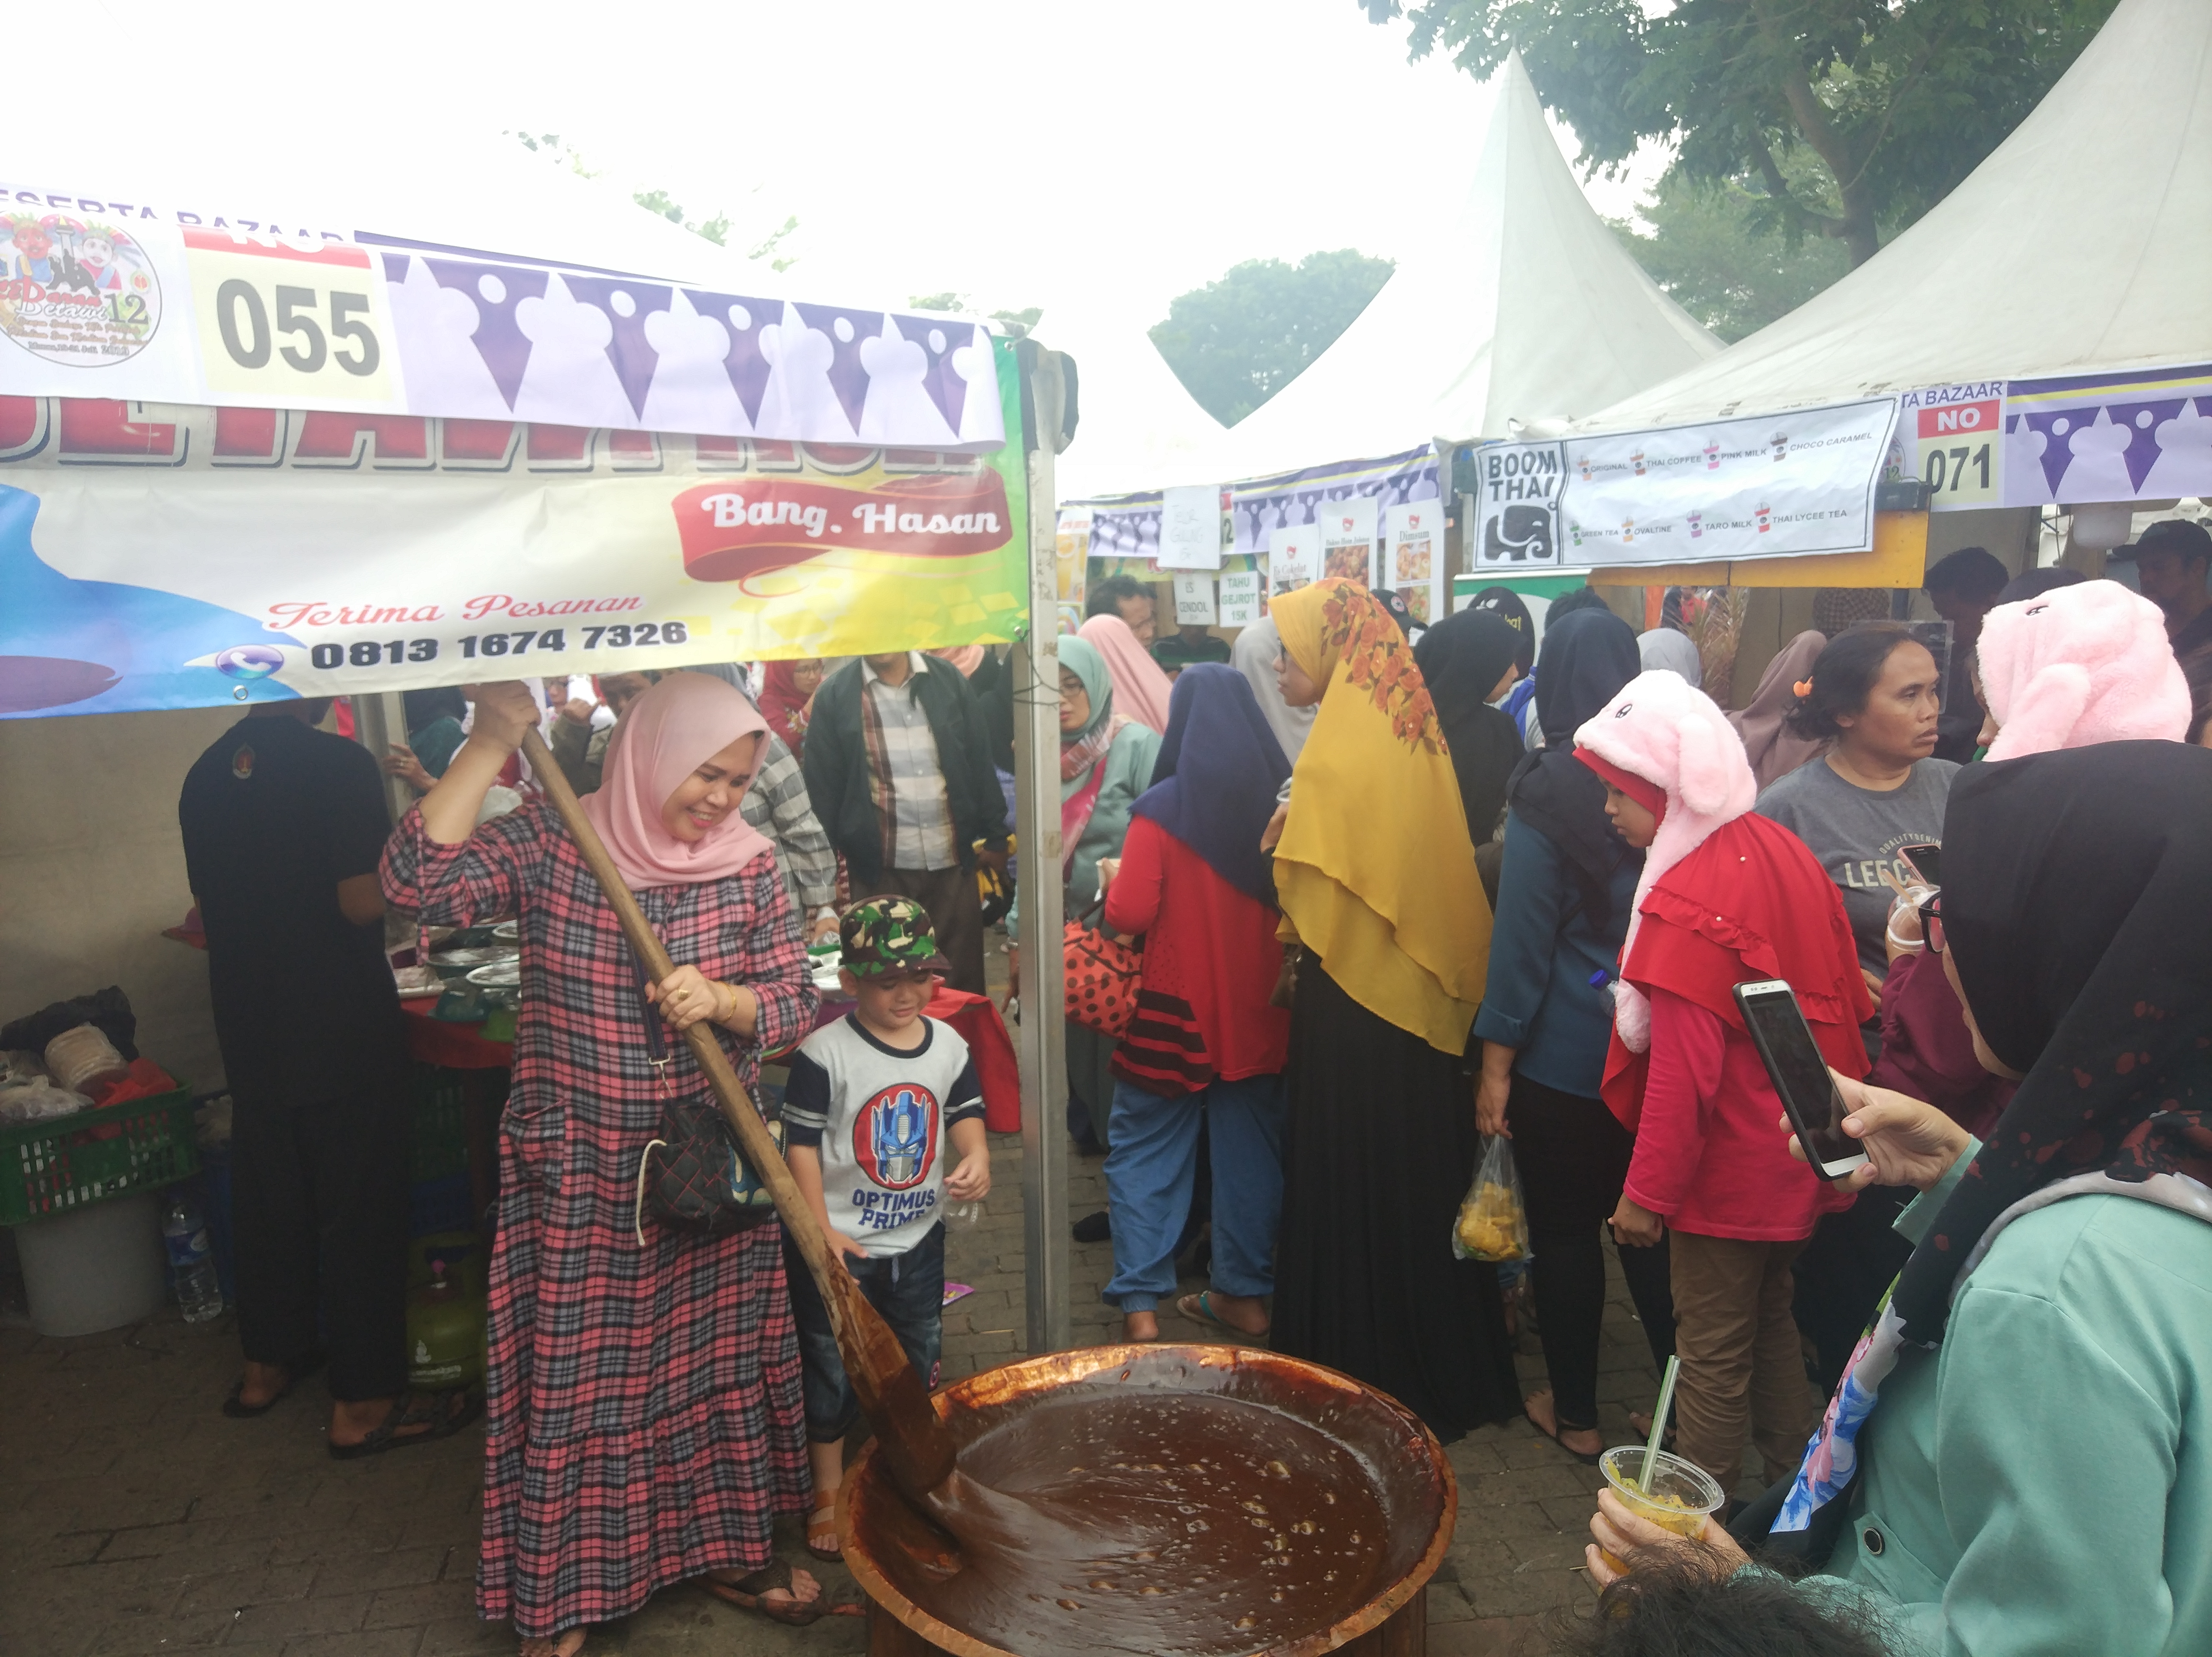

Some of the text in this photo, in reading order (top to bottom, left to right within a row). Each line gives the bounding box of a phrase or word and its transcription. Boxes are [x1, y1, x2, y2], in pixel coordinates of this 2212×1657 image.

[104, 293, 148, 324] 12
[216, 278, 380, 377] 055
[1925, 381, 2002, 405] BAZAAR
[1938, 407, 1980, 431] NO
[1790, 432, 1872, 451] CHOCO CARAMEL
[1667, 456, 1701, 465] COFFEE
[1721, 448, 1767, 460] PINK MILK
[1489, 450, 1557, 478] BOOM
[1591, 464, 1628, 473] ORIGINAL
[1926, 443, 1990, 494] 071
[1489, 476, 1555, 501] THAI
[701, 492, 1001, 538] Bang. Hasan
[1772, 510, 1846, 523] THAI LYCEE TEA
[1634, 525, 1671, 535] OVALTINE
[1705, 520, 1752, 531] TARO MILK
[1399, 530, 1429, 542] Dimsum
[1227, 577, 1249, 588] TAHU
[1179, 602, 1209, 613] CENDOL
[1221, 593, 1256, 604] GEJROT
[268, 594, 643, 630] Terima Pesanan
[1231, 610, 1247, 621] 15K
[310, 622, 687, 669] 0813 1674 7326
[852, 1188, 935, 1209] OPTIMUS
